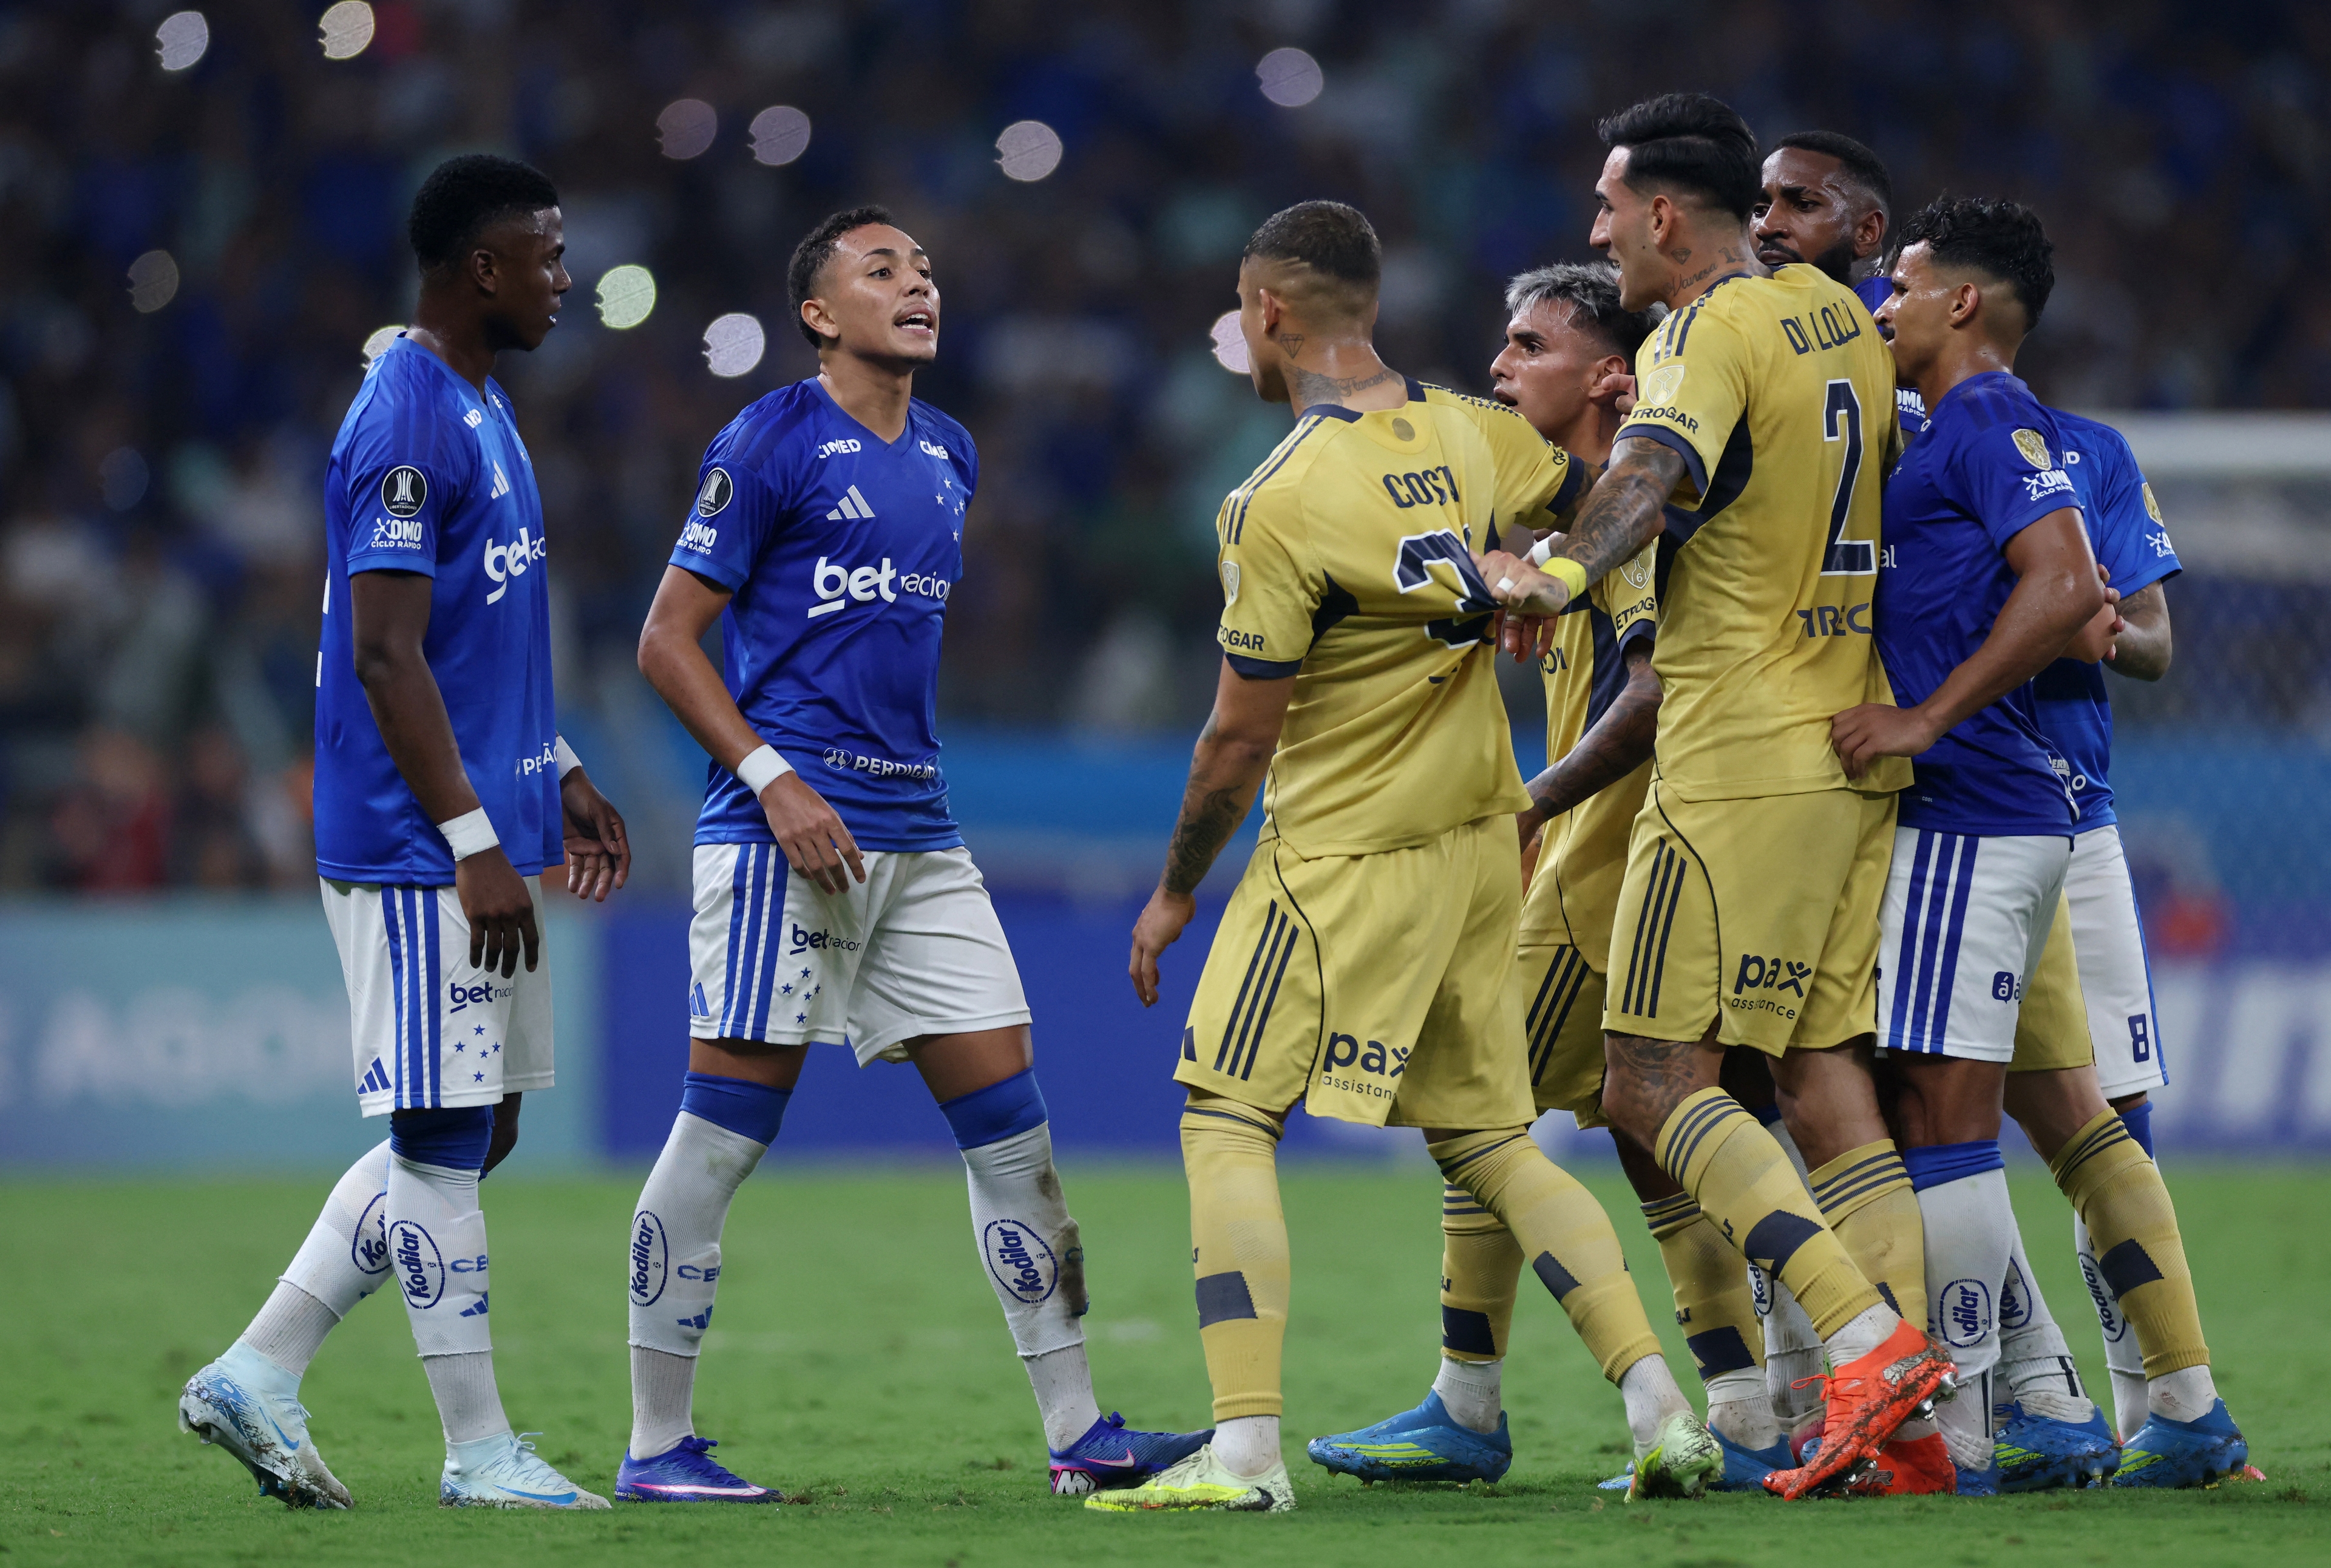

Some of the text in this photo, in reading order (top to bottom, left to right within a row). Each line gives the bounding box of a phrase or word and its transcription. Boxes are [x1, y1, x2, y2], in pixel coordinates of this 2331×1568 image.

[1820, 378, 1877, 576] 2
[2030, 487, 2055, 501] CICLO
[390, 519, 422, 542] OMO
[397, 540, 421, 549] RÁPIDO
[813, 556, 897, 603] bet
[1636, 572, 1643, 583] 6
[792, 923, 830, 951] bet
[450, 982, 493, 1004] bet
[2128, 1013, 2150, 1063] 8
[398, 1227, 431, 1298] Kodilar
[631, 1218, 654, 1298] Kodilar
[997, 1226, 1045, 1292] Kodilar
